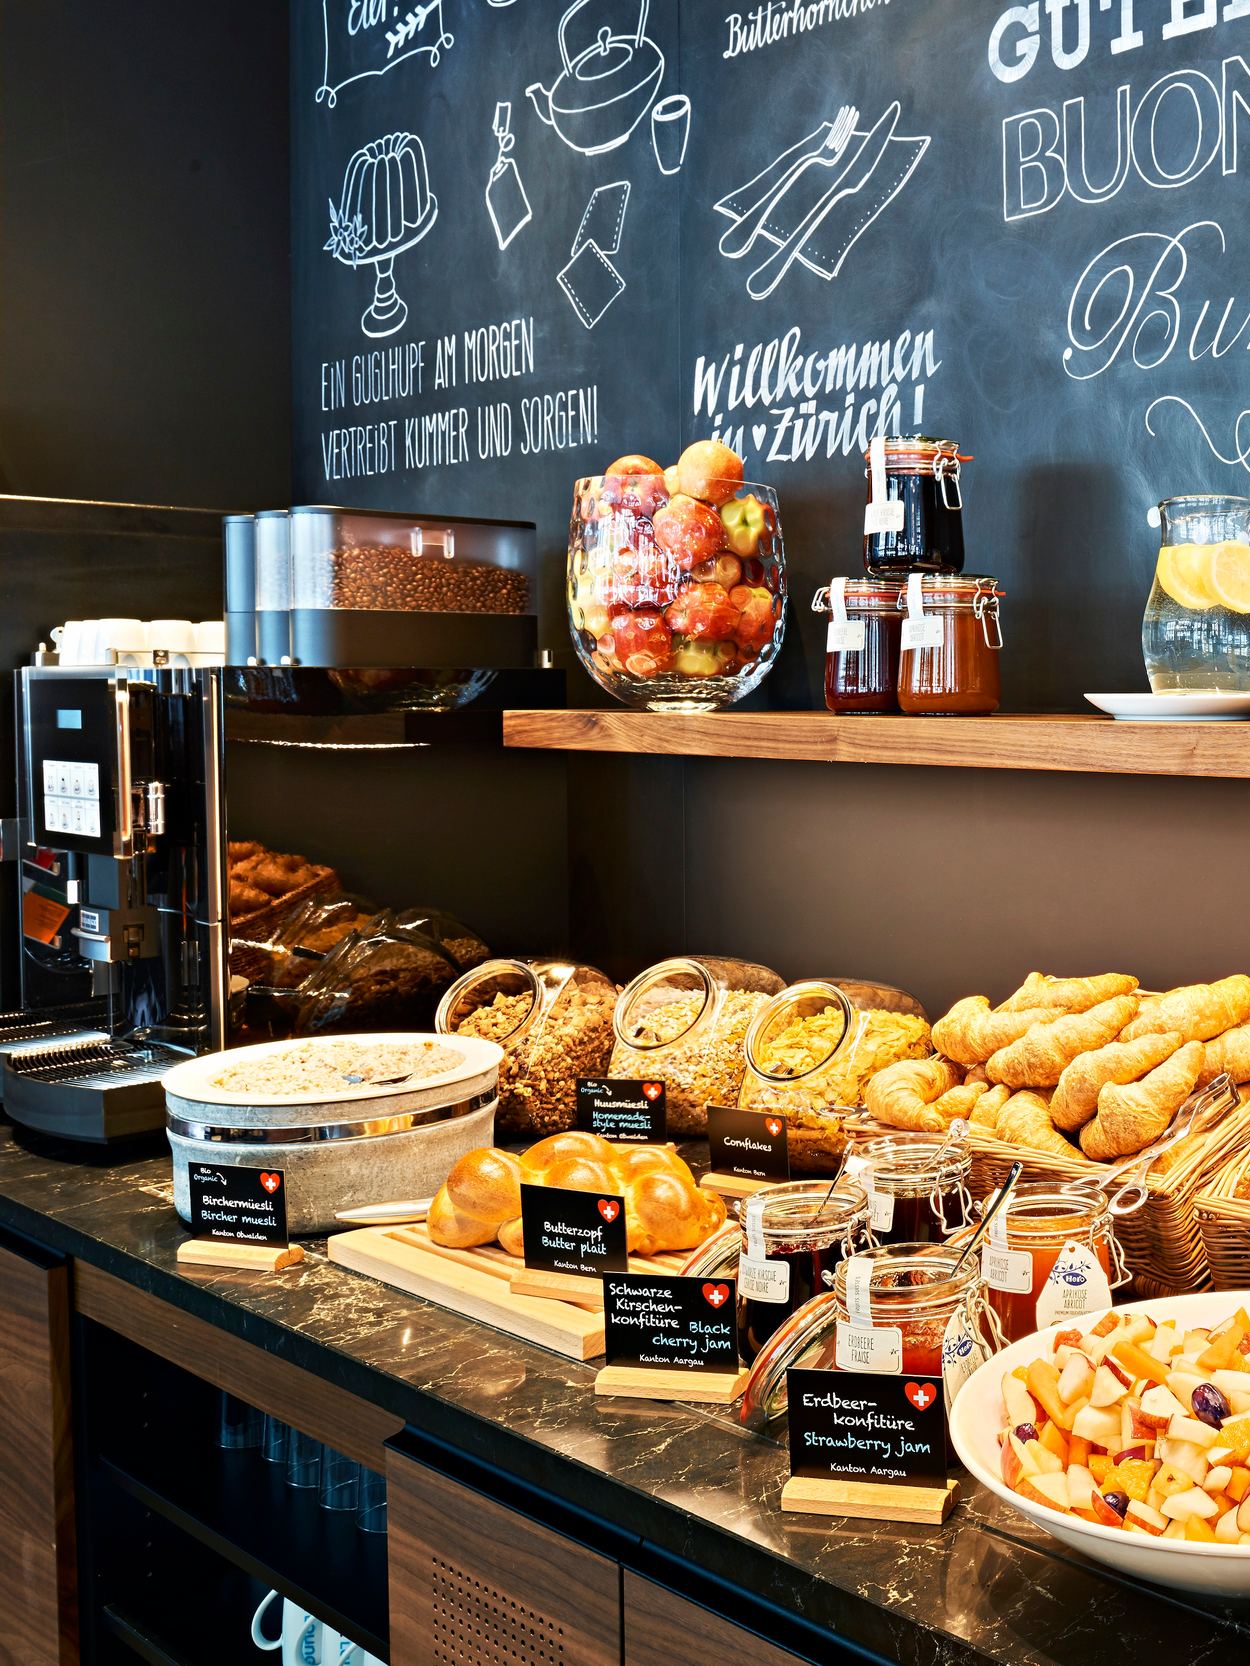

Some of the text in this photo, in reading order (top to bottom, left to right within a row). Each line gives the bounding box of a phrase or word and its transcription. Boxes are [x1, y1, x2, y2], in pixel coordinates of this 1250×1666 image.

[352, 341, 426, 407] GUGLHUPF
[434, 334, 457, 390] AM
[464, 316, 534, 384] MORGEN
[693, 326, 942, 417] Willkommen
[405, 407, 469, 470] KUMMER
[478, 402, 512, 460] UND
[521, 385, 599, 455] SORGEN!
[594, 1098, 649, 1109] Huusmüesli
[592, 1111, 651, 1121] Homemade-
[592, 1120, 651, 1132] style muesli
[723, 1136, 772, 1152] Cornflakes
[193, 1174, 218, 1183] Organic
[733, 1166, 766, 1177] Kanton Bern
[202, 1195, 274, 1211] Birchermüesli
[201, 1210, 277, 1226] Bircher muesli
[212, 1229, 268, 1241] Kanton Obwalden
[543, 1221, 603, 1244] Butterzopf
[541, 1236, 607, 1258] Butter plait
[554, 1260, 597, 1273] Kanton Bern
[1065, 1275, 1085, 1283] Hero
[609, 1283, 673, 1298] Schwarze
[1063, 1289, 1088, 1299] APRIKOSE
[616, 1298, 682, 1312] Kirschen-
[1063, 1299, 1086, 1309] ABRICOT
[611, 1311, 680, 1329] konfitüre
[689, 1321, 731, 1334] Black
[652, 1333, 731, 1354] cherry jam
[848, 1334, 874, 1350] ERDBEERE
[639, 1354, 704, 1367] Kanton Aargau
[851, 1349, 869, 1364] FRAISE
[802, 1392, 877, 1410] Erdbeer-
[833, 1411, 915, 1431] konfitüre
[804, 1432, 931, 1458] Strawberry jam
[830, 1463, 907, 1478] Kanton Aargau
